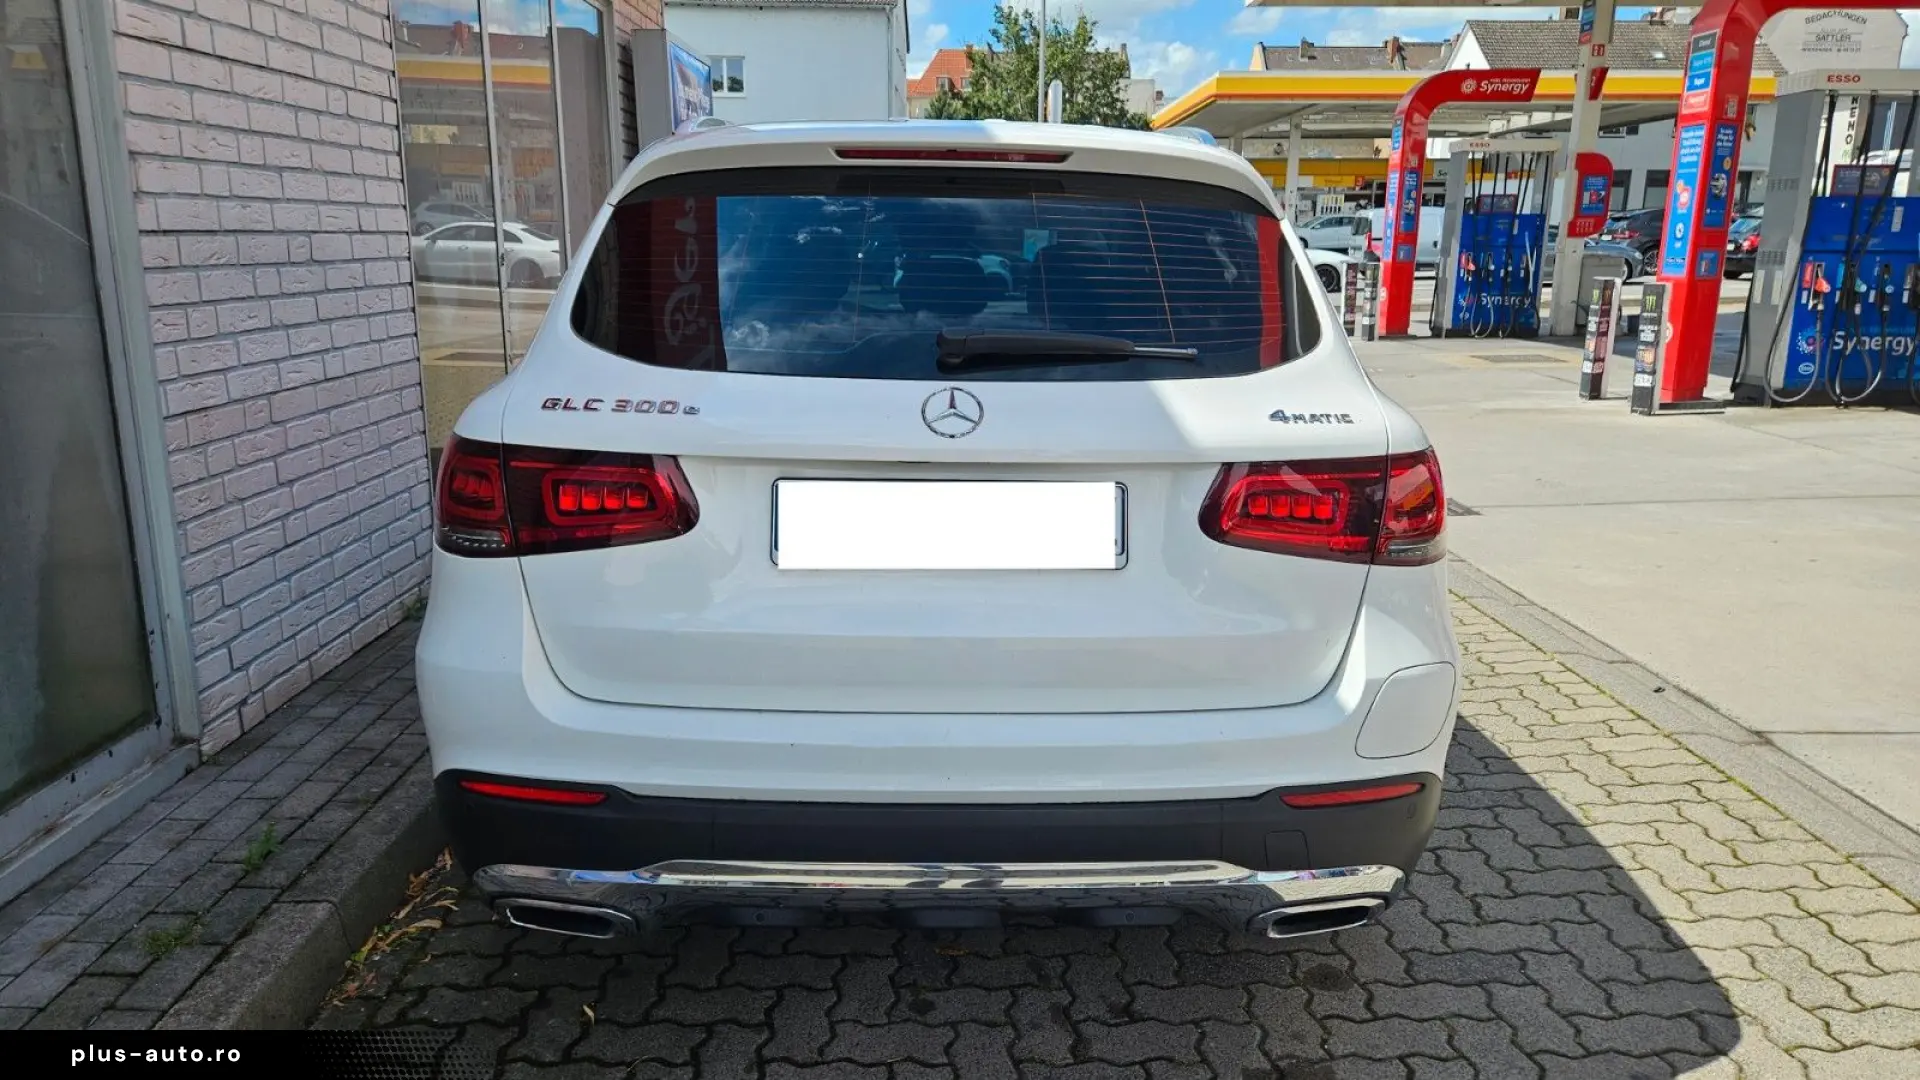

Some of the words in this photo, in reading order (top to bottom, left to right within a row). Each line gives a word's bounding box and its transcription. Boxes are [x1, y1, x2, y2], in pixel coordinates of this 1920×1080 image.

[1804, 9, 1867, 25] BEDACHUNGEN
[1815, 34, 1852, 43] SATTLER
[1827, 75, 1861, 83] ESSO
[1480, 80, 1529, 94] Synergy
[541, 397, 605, 412] GLC
[1268, 409, 1355, 424] 4MATIC
